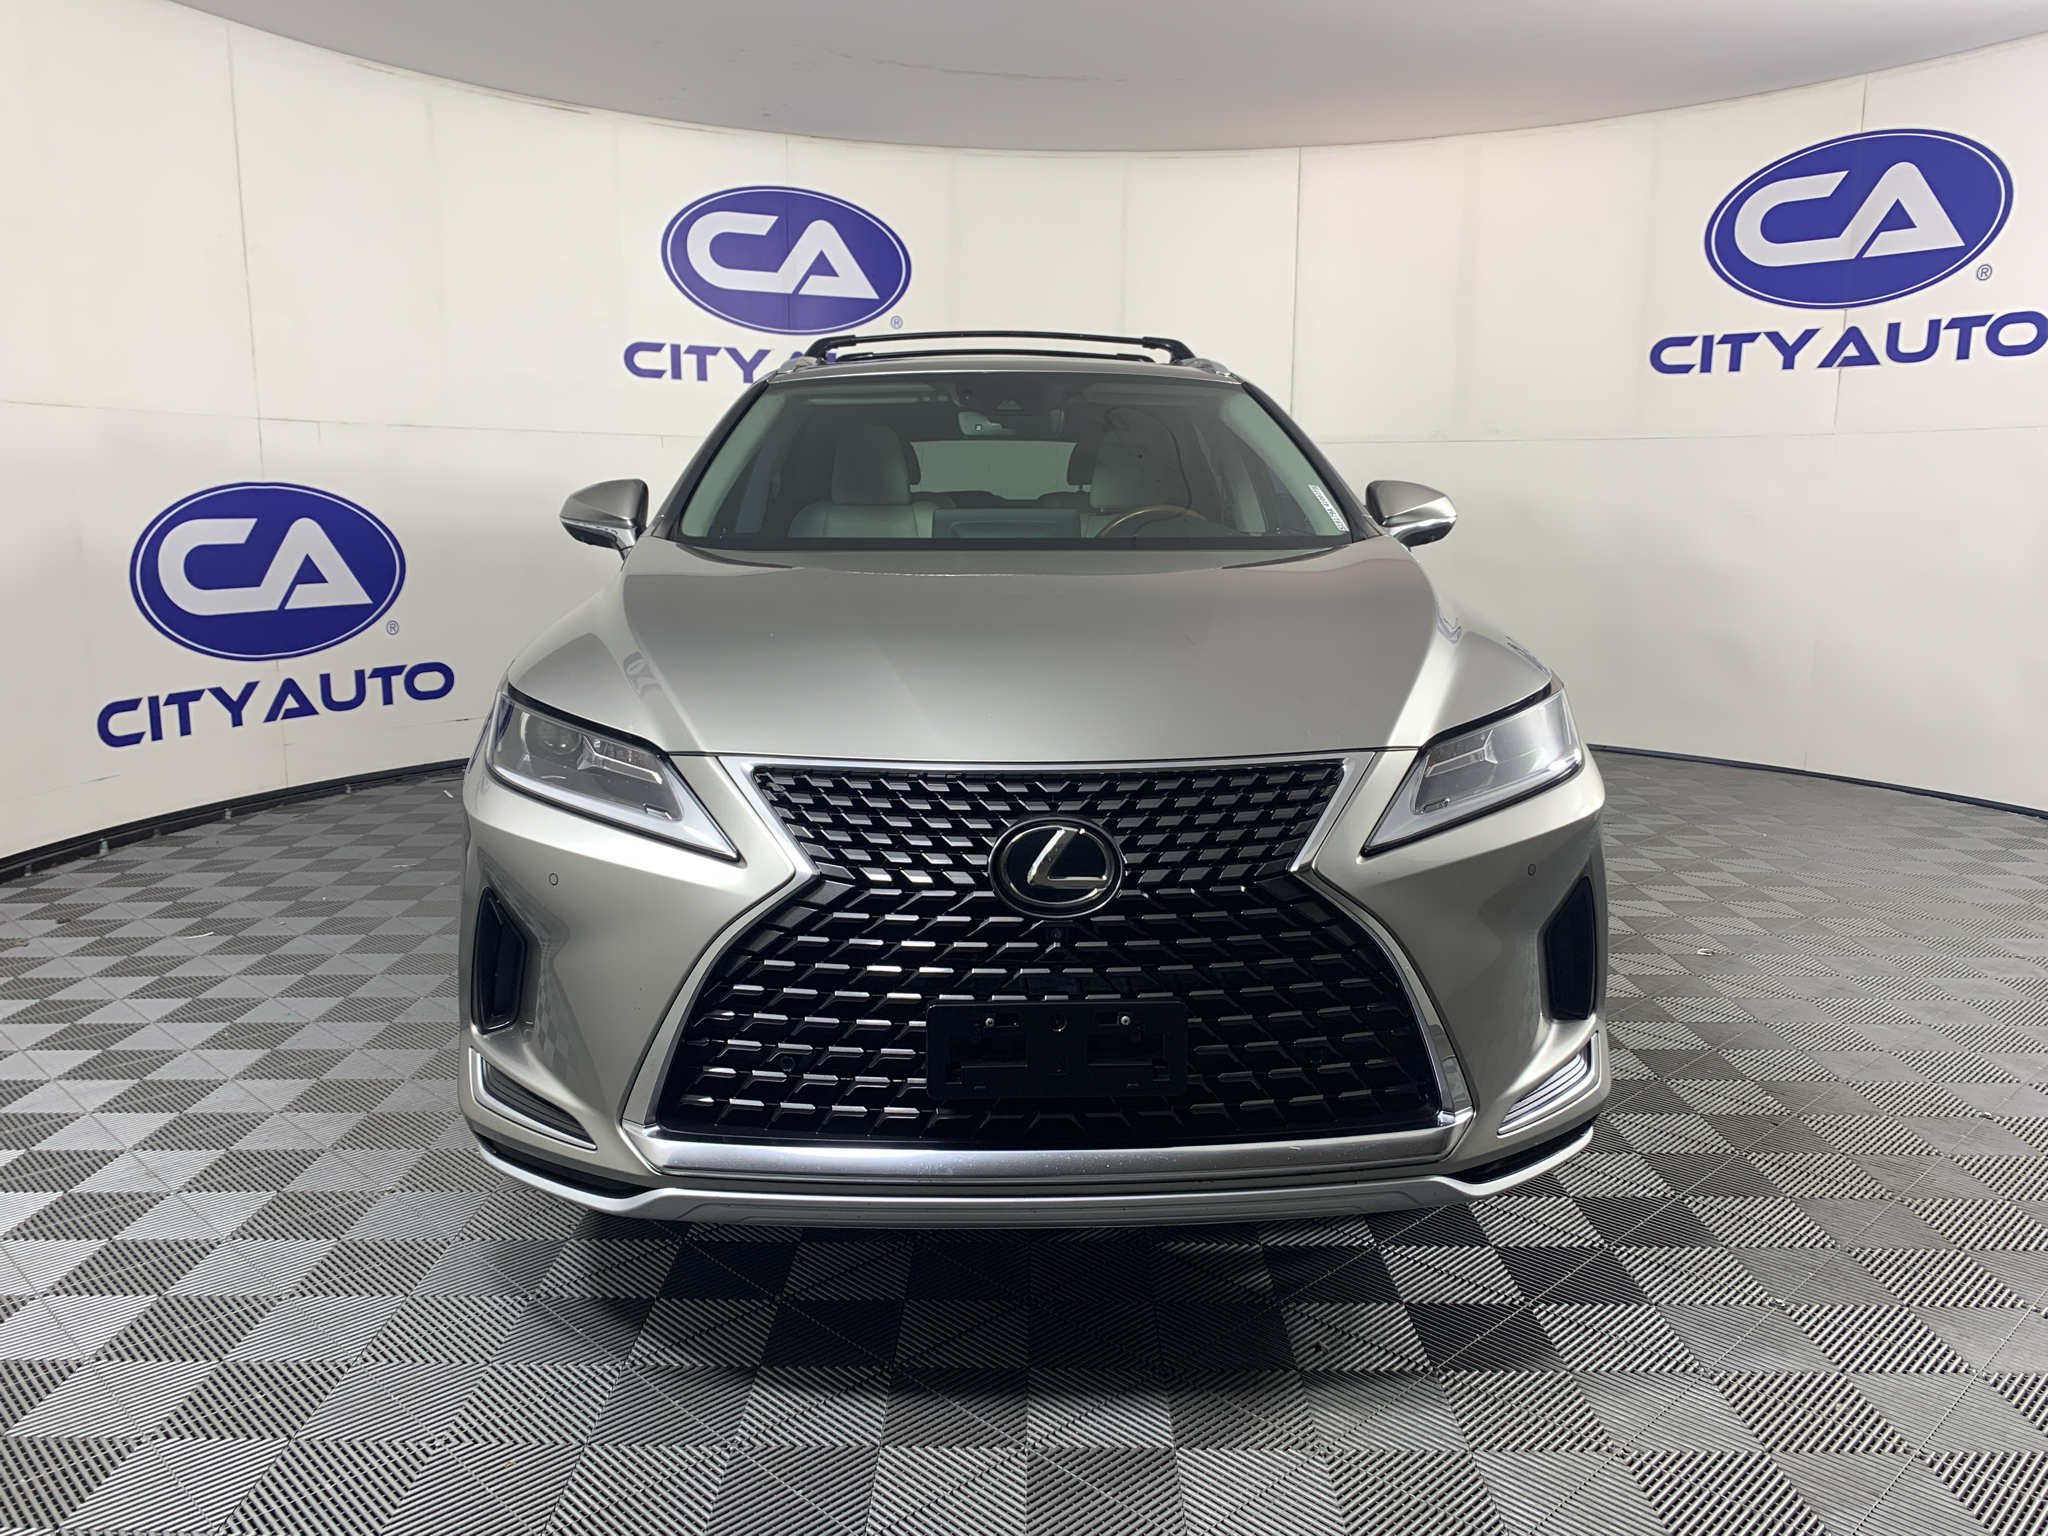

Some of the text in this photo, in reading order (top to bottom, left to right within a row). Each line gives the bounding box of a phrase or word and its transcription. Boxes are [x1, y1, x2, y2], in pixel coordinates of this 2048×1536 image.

[686, 210, 880, 300] CA
[1734, 161, 1966, 268] CA
[623, 341, 772, 384] CITY
[1649, 310, 2048, 374] CITY AUTO
[157, 517, 374, 616] CA
[96, 661, 455, 748] CITY AUTO
